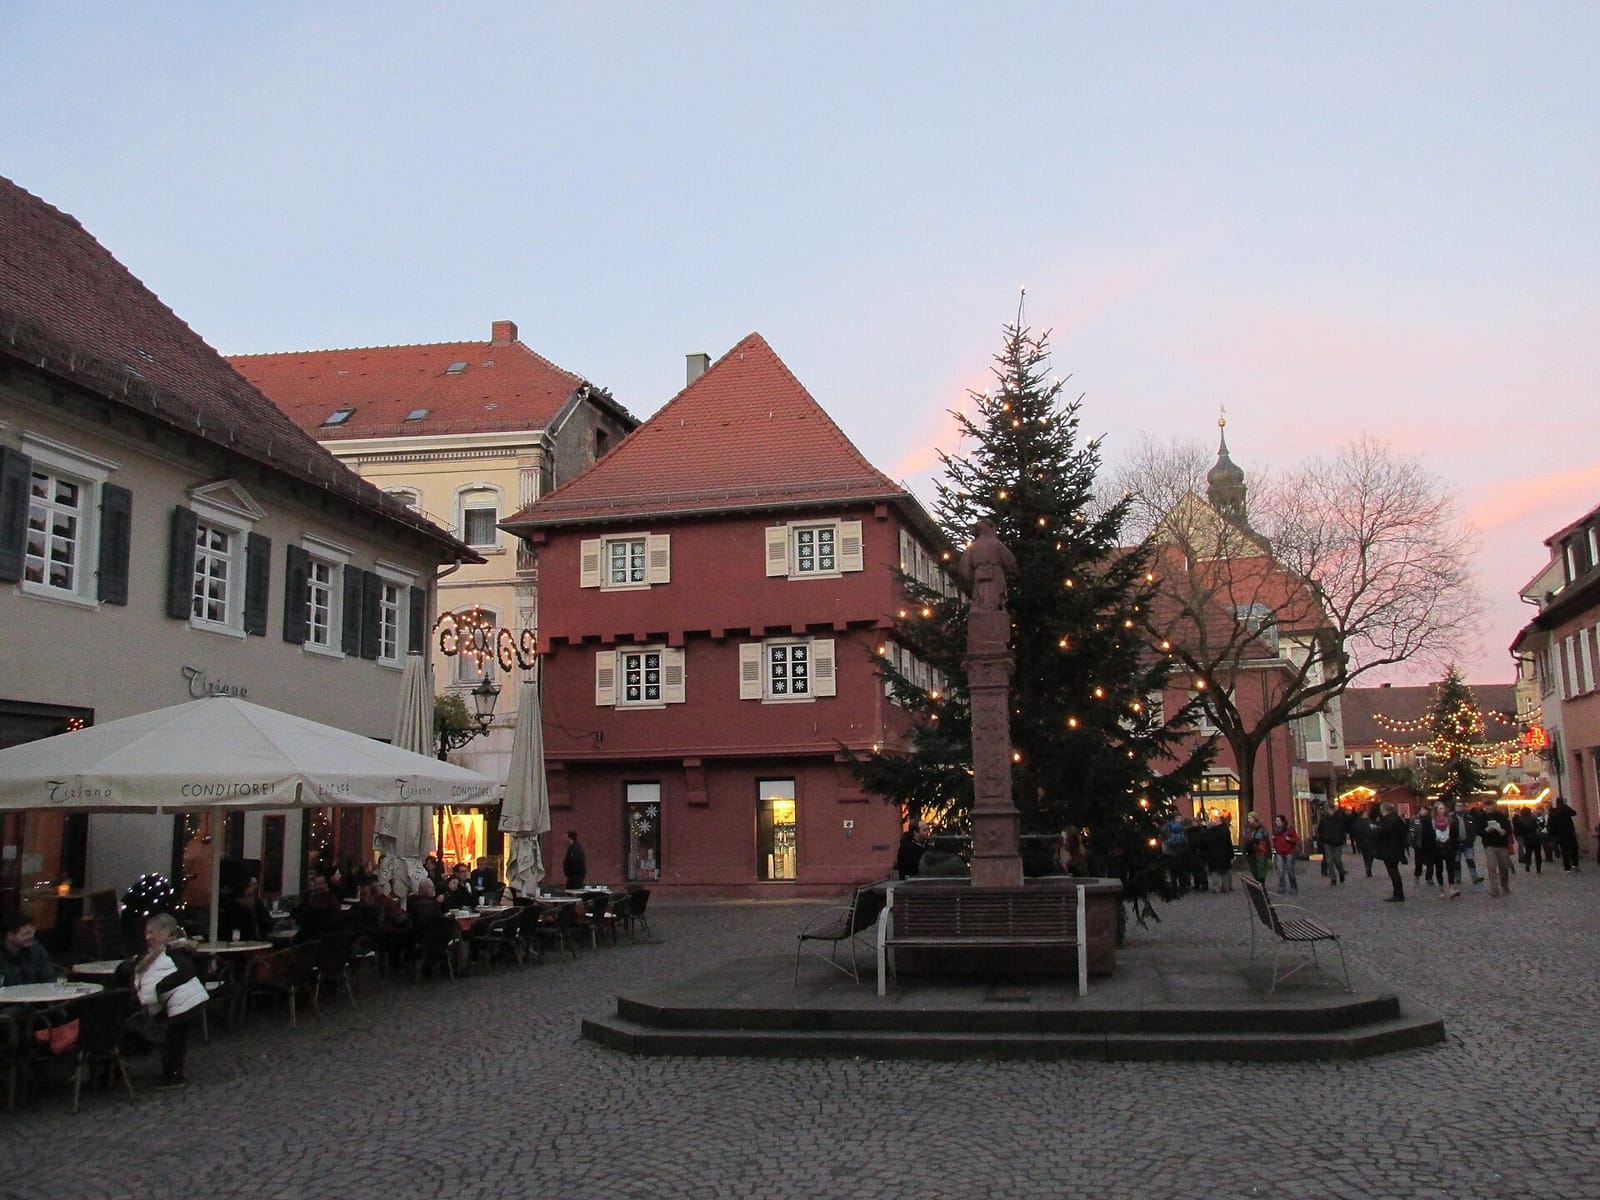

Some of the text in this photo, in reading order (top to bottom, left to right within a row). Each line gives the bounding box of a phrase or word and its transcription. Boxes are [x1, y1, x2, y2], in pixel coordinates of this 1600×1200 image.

[182, 664, 249, 699] Tiziano
[47, 779, 112, 803] Tiziano
[181, 783, 275, 797] CONDITOREI
